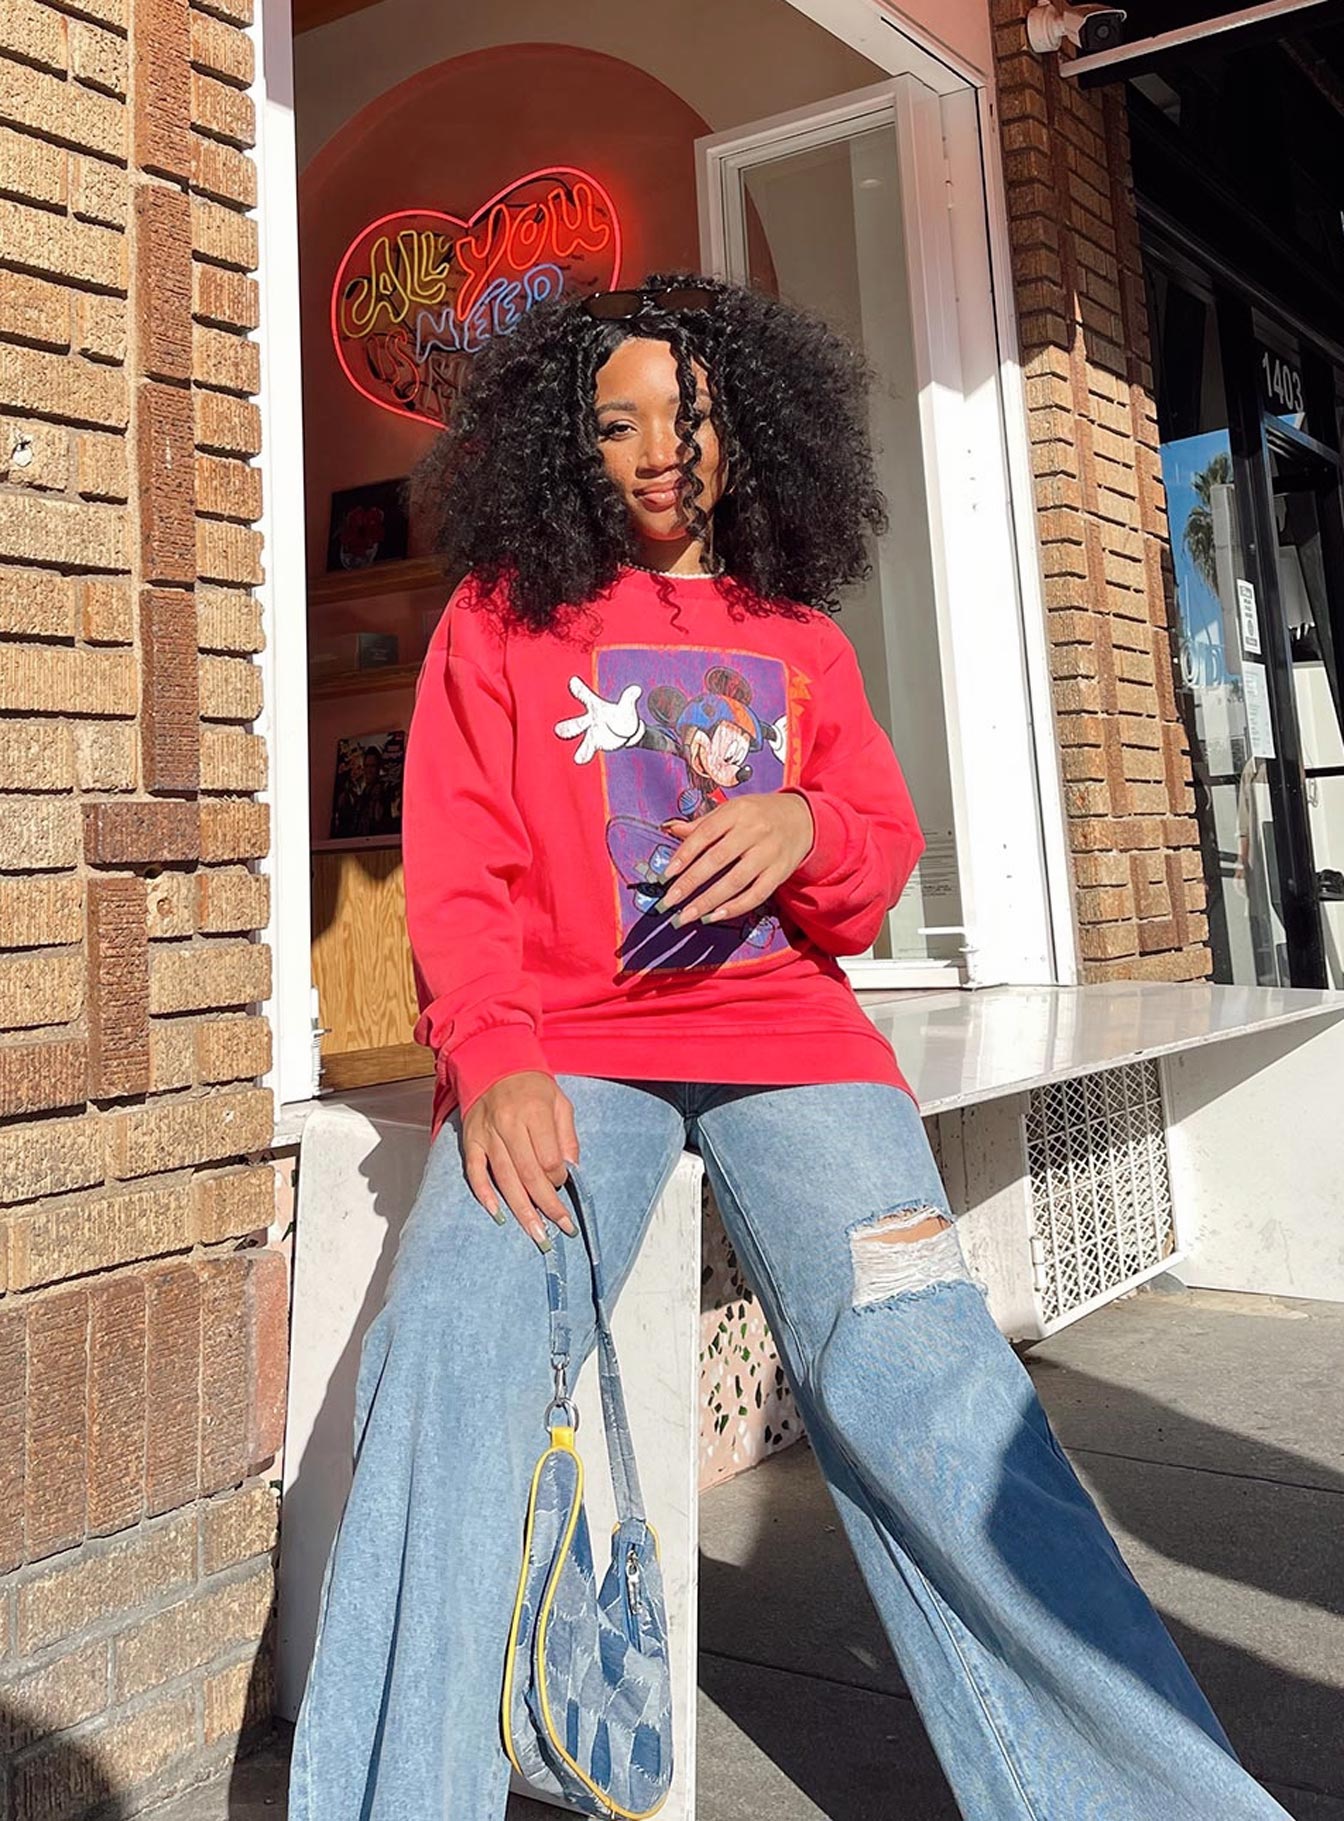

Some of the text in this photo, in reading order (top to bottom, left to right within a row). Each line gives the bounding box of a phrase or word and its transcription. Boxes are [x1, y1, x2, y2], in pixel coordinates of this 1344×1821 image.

[341, 183, 610, 338] ALL YOU
[416, 263, 564, 363] NEED
[1262, 352, 1304, 413] 1403
